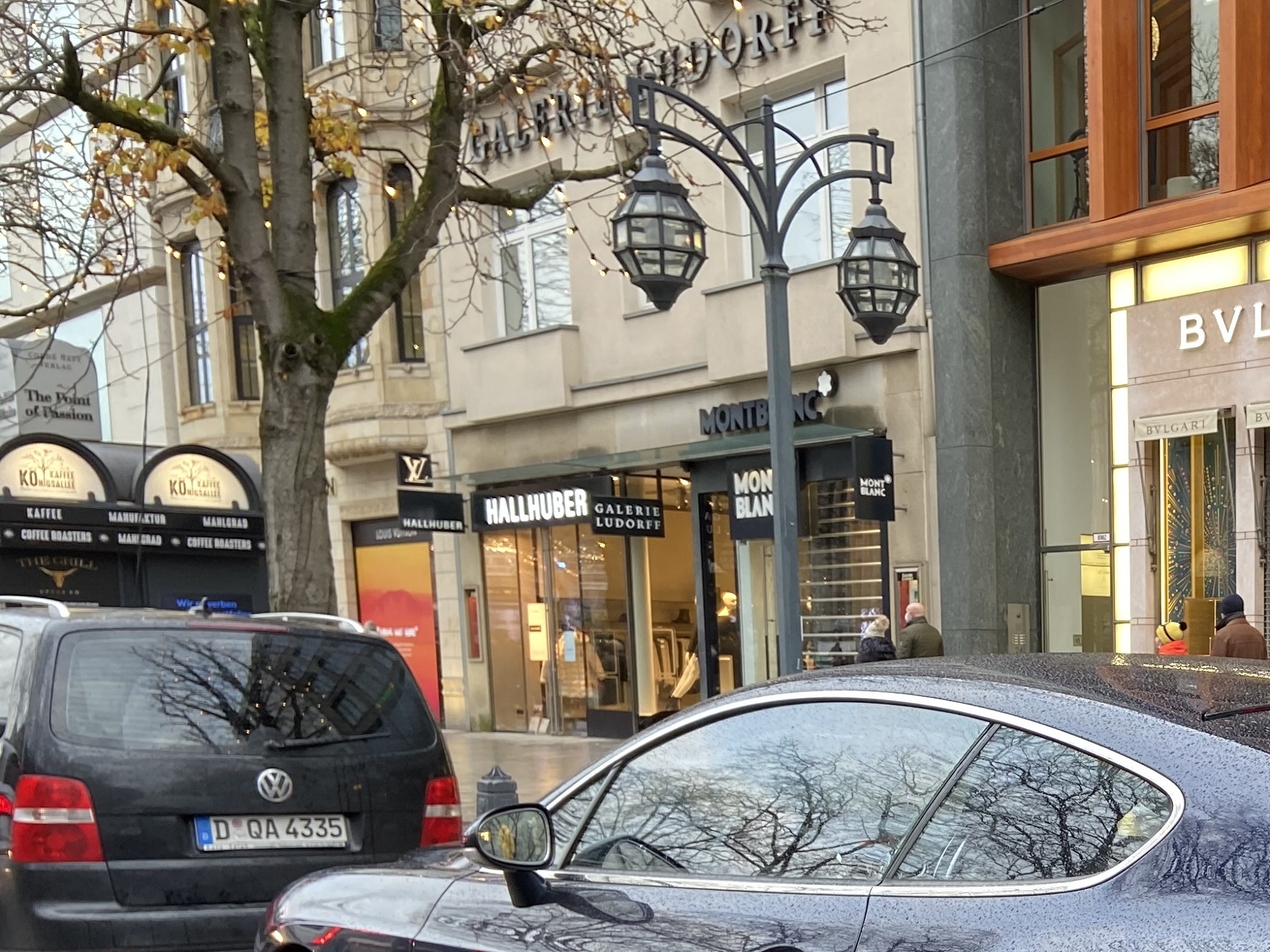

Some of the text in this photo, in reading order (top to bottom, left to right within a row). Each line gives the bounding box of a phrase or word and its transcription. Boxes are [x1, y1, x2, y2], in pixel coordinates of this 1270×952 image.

[24, 388, 91, 407] The Point
[25, 405, 40, 418] of
[42, 405, 94, 422] Passion
[699, 389, 824, 435] MONTBNC
[1146, 419, 1206, 436] BVLGARI
[733, 469, 773, 495] MON
[859, 477, 885, 488] MONT
[860, 487, 886, 497] BLANC
[485, 487, 589, 525] HALLHUBER
[594, 502, 660, 517] GALERIE
[735, 494, 774, 519] BLAN
[27, 507, 63, 520] KAFFEE
[108, 511, 167, 525] MANUFAKTUR
[402, 518, 463, 531] HALLHUBER
[596, 517, 661, 531] LUDORFF
[21, 528, 92, 543] COFFEE ROASTERS
[187, 536, 252, 550] COFFEE ROASTERS
[213, 817, 343, 840] D QA 4335
